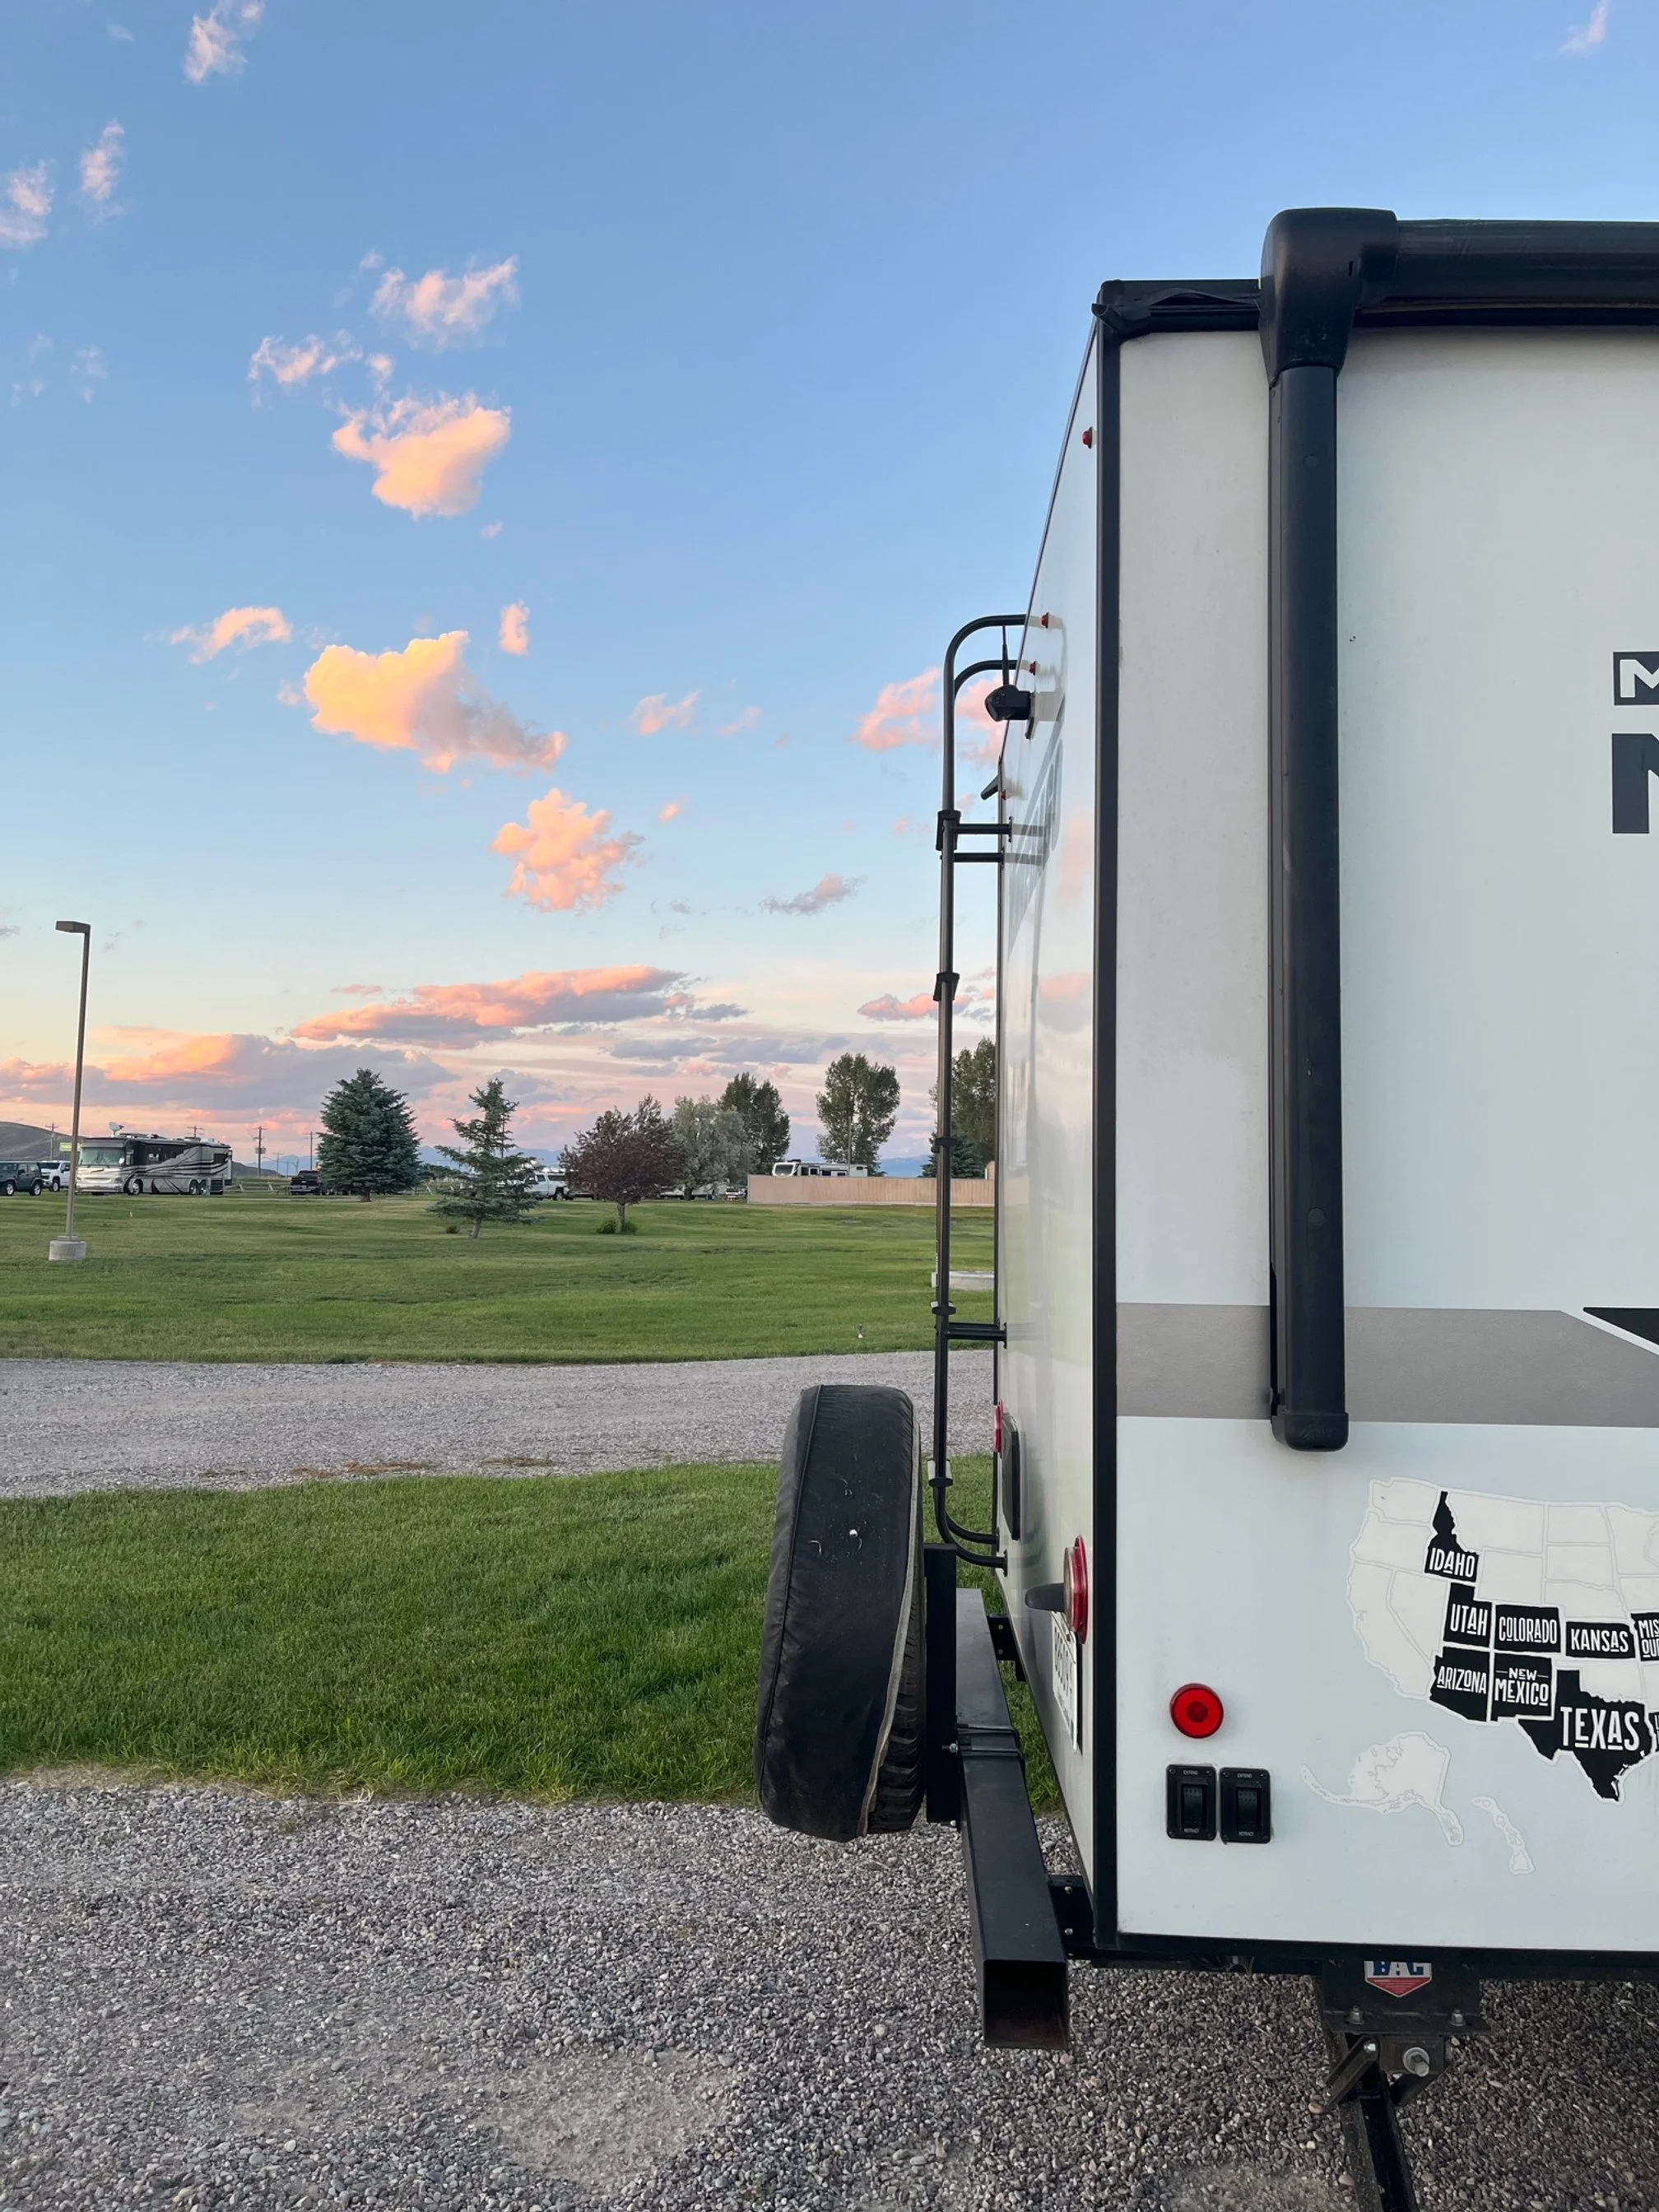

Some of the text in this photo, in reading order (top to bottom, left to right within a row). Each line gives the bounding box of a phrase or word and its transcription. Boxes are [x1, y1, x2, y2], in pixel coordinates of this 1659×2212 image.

[1429, 1547, 1475, 1578] IDAHO
[1450, 1603, 1488, 1636] UTAH
[1499, 1616, 1557, 1644] COLORADO
[1571, 1628, 1629, 1652] KANSAS
[1437, 1666, 1487, 1694] ARIZONA
[1508, 1668, 1537, 1680] NEW
[1494, 1678, 1549, 1706] MEXICO
[1560, 1707, 1640, 1750] TEXAS
